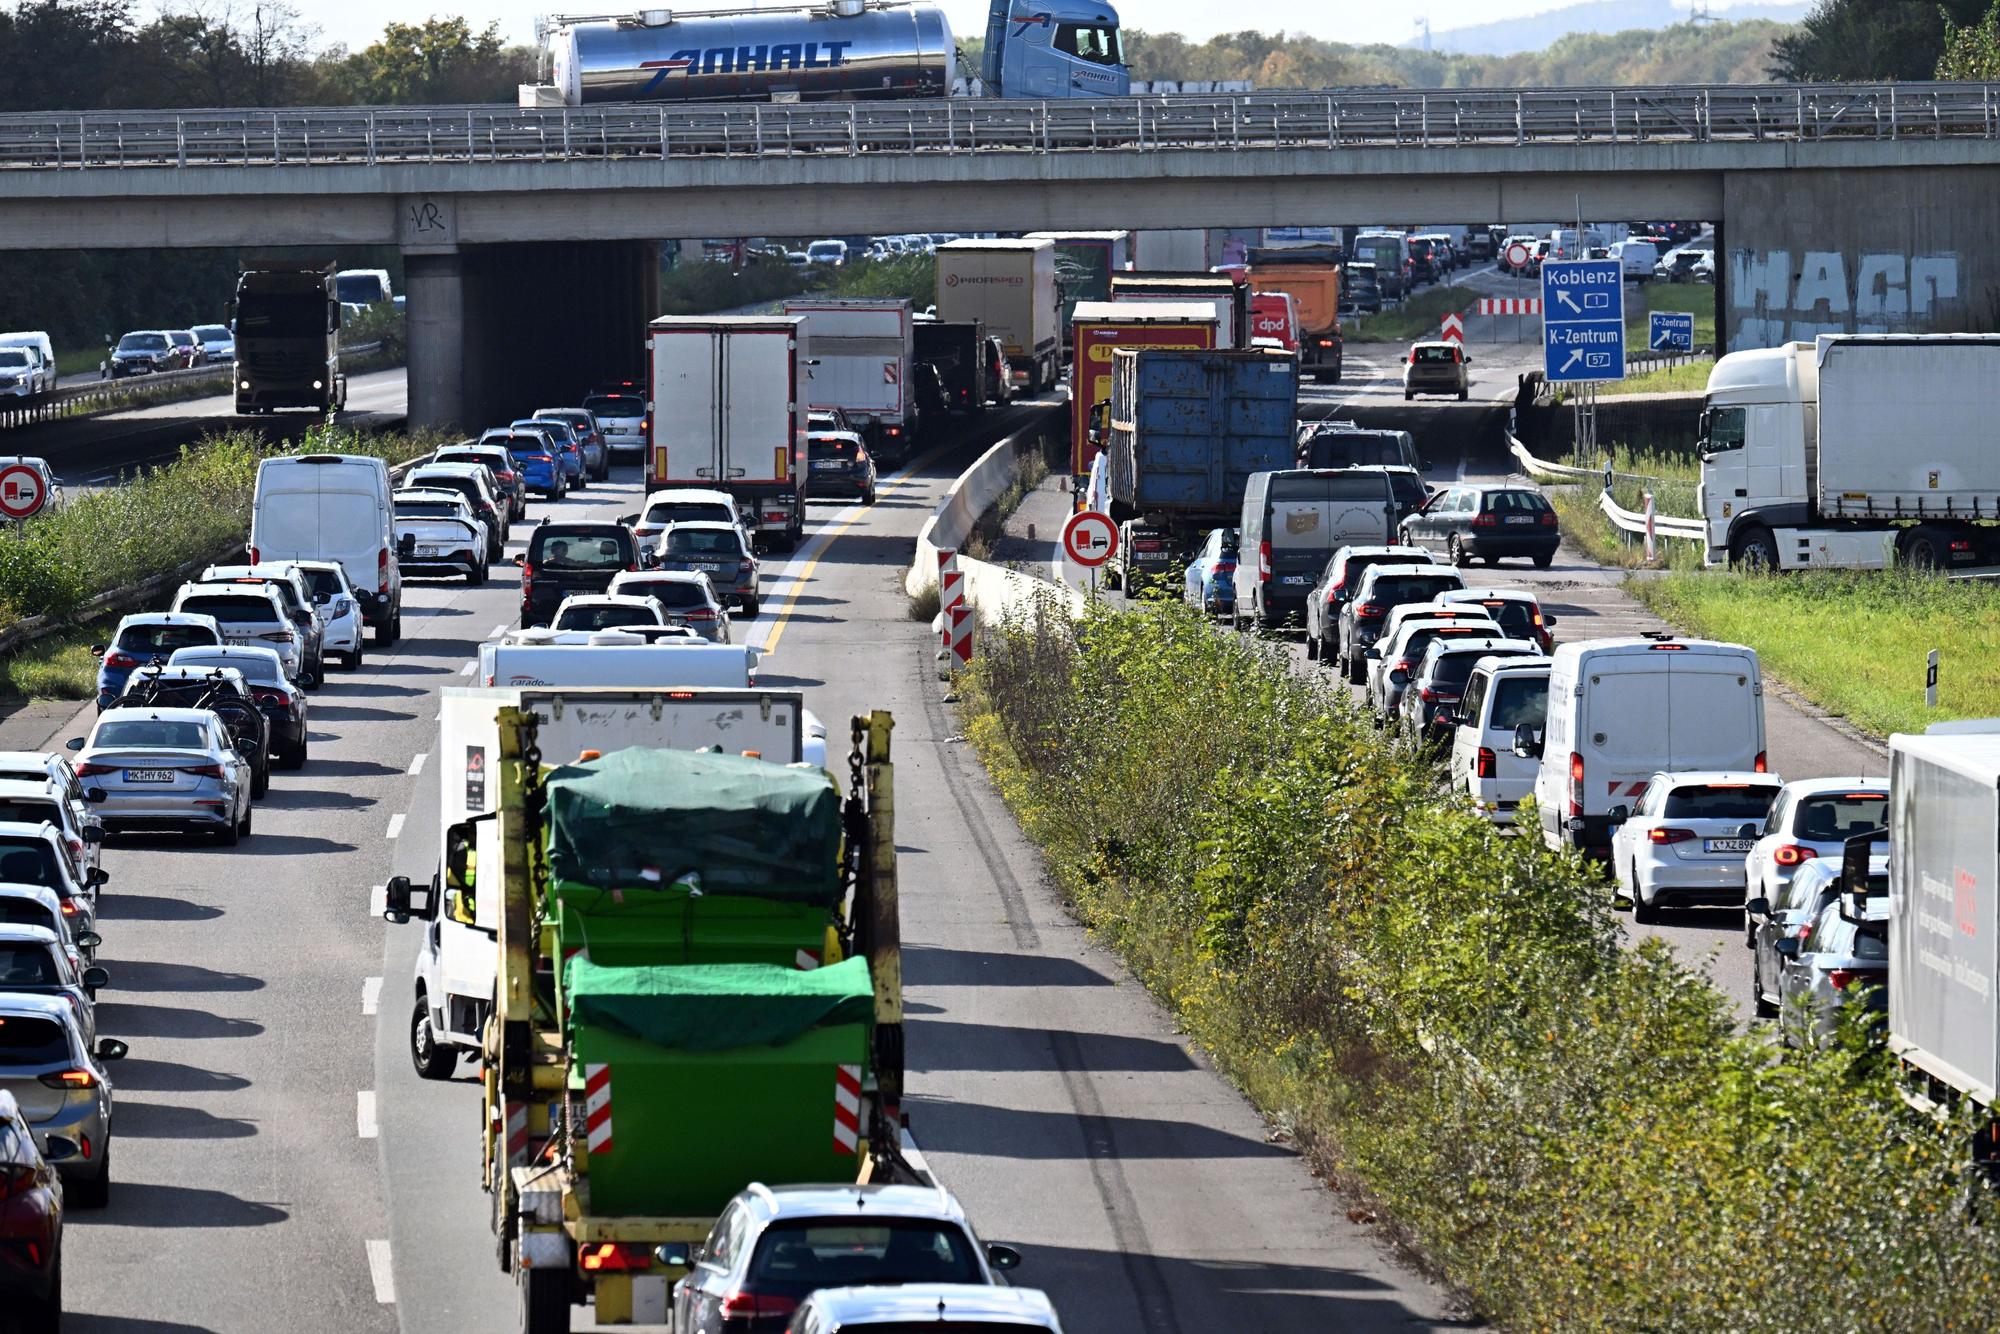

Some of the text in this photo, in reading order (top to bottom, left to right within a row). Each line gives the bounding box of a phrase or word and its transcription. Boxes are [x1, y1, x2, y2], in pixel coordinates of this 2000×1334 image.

[640, 41, 853, 92] ANHALT
[1072, 70, 1117, 82] ANHALT
[960, 276, 1024, 284] PROFISPED
[1547, 269, 1617, 286] Koblenz
[1259, 317, 1285, 333] dpd
[1653, 317, 1690, 328] K-Zentrum
[1550, 328, 1618, 344] K-Zentrum
[1592, 355, 1604, 365] 57
[510, 678, 545, 687] carado
[157, 770, 173, 780] 962
